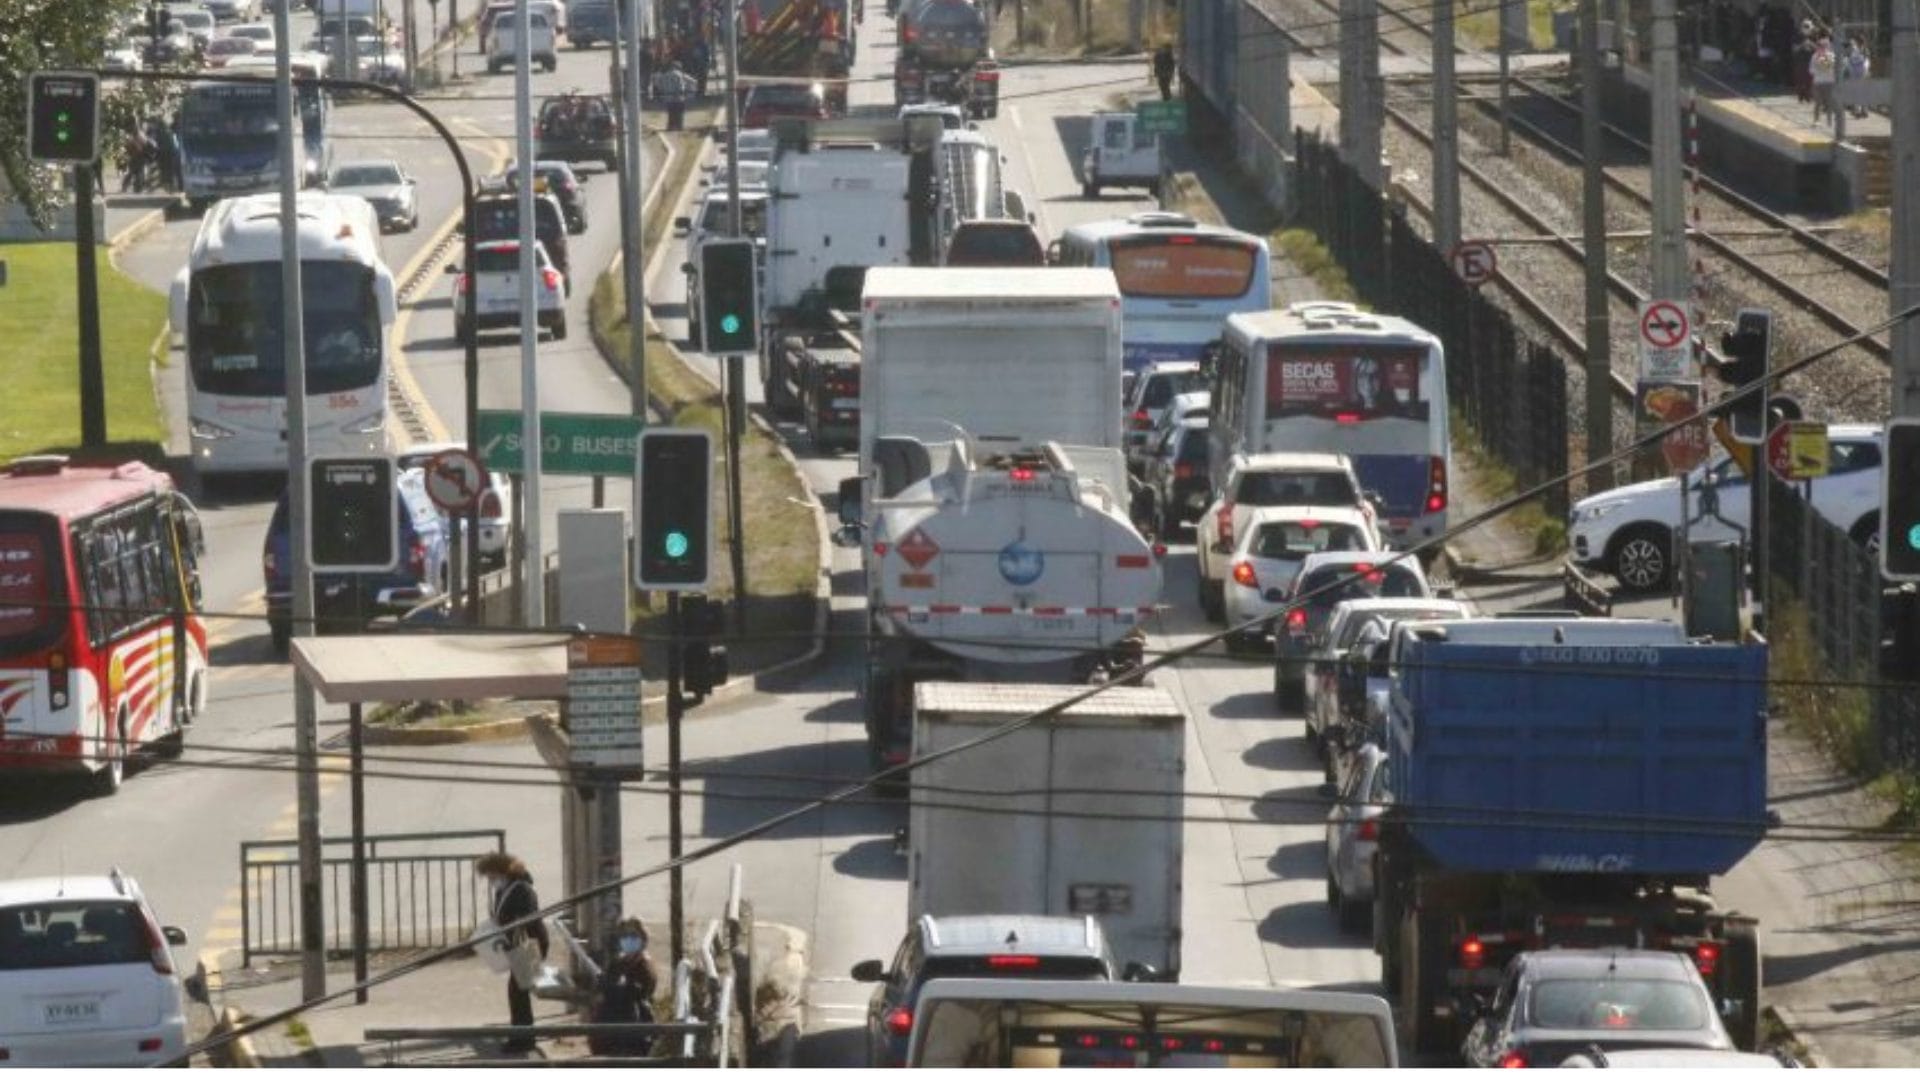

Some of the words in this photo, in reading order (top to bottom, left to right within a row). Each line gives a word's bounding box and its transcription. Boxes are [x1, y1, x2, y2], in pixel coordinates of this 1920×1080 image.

[1282, 361, 1335, 379] BECAS
[505, 433, 561, 452] SO
[573, 435, 637, 455] BUSES
